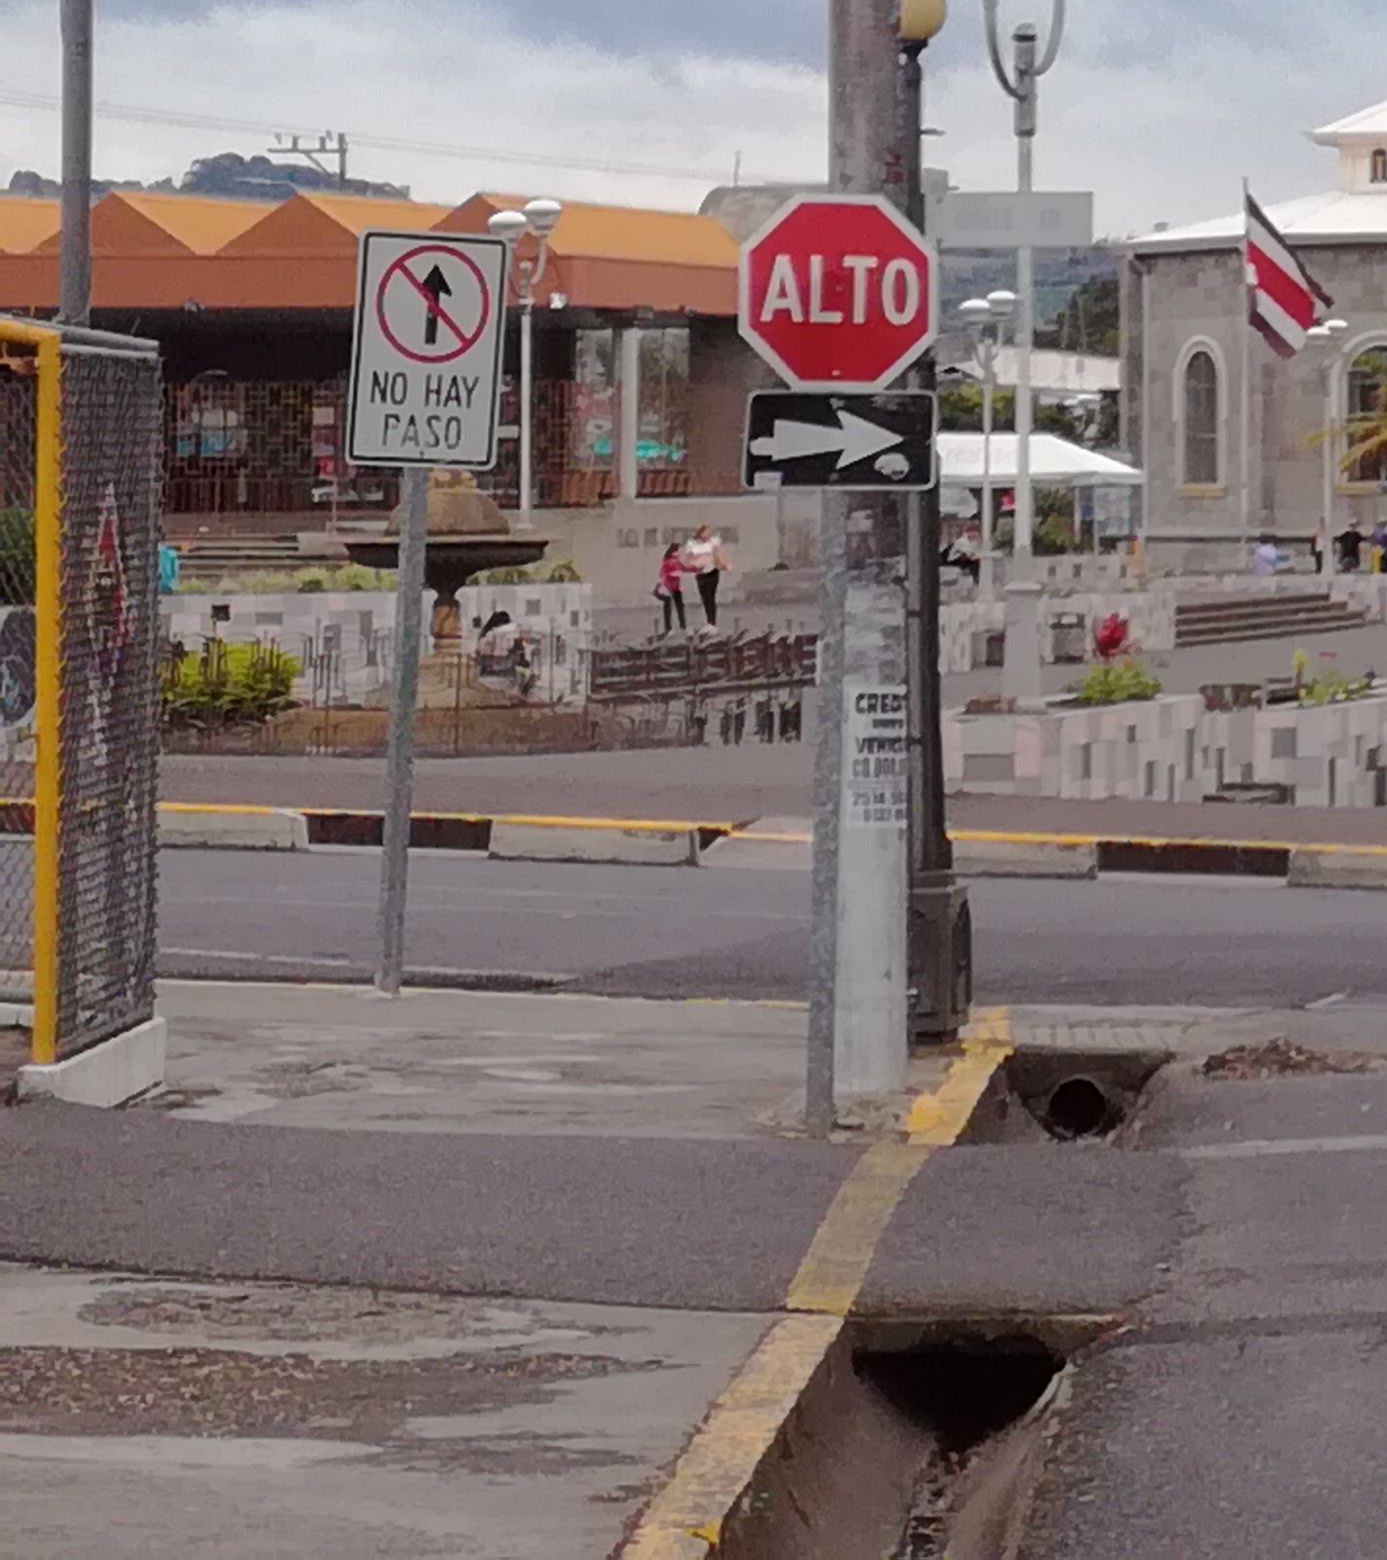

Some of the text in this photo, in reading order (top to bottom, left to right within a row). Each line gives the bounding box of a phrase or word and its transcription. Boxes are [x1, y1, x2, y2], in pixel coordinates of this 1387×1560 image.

[760, 254, 921, 326] ALTO
[369, 370, 480, 409] NO HAY
[382, 413, 462, 450] PASO
